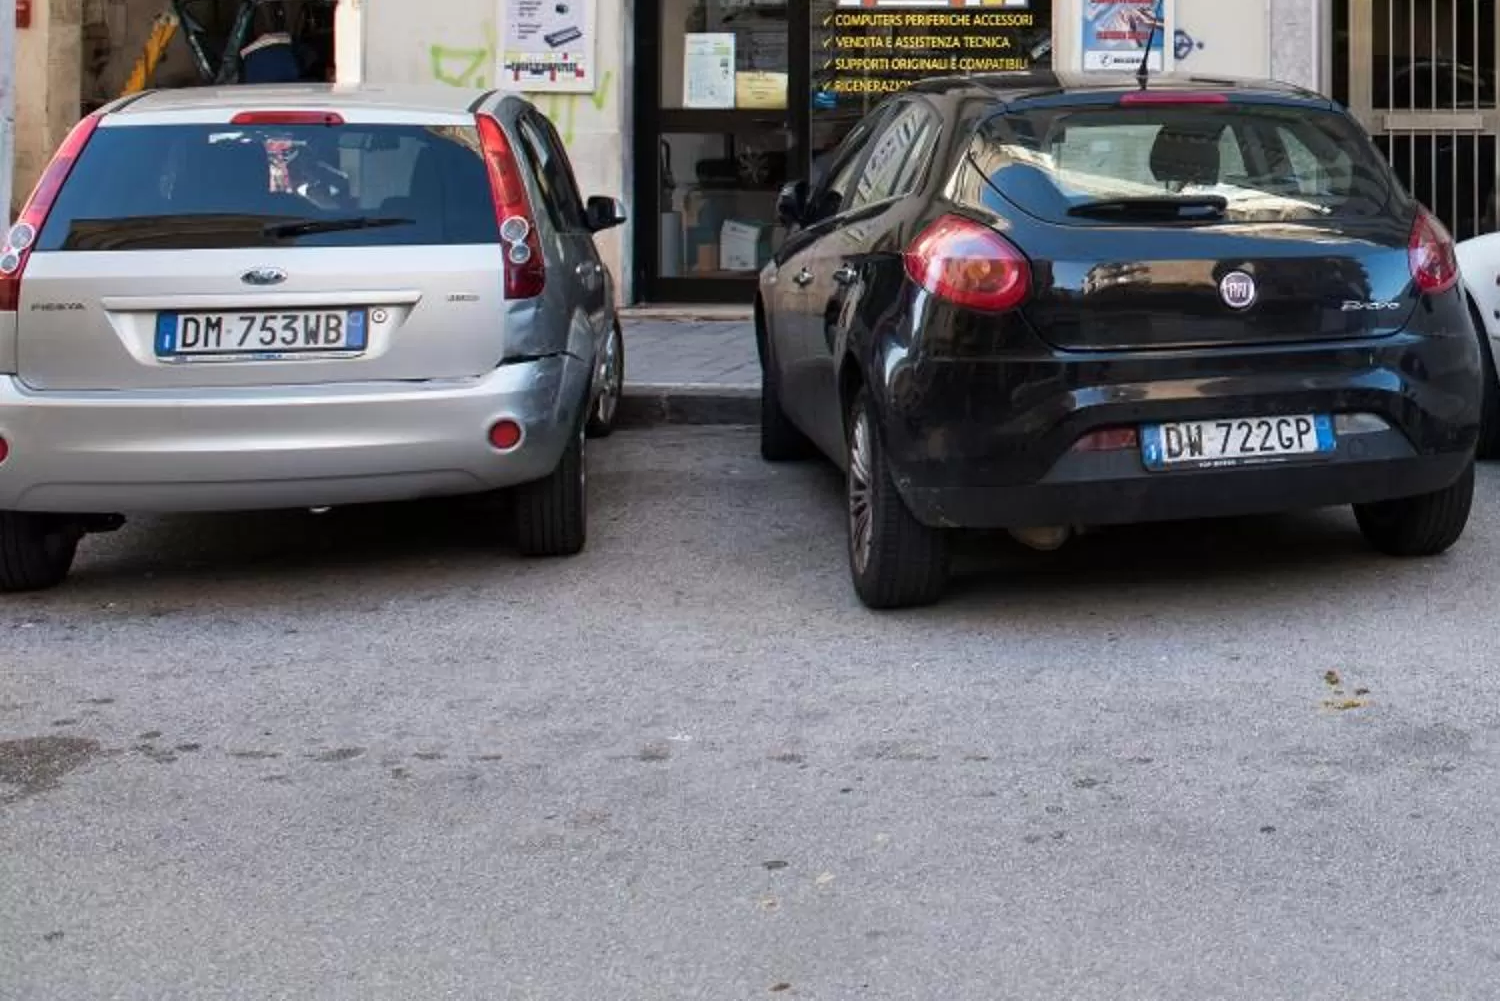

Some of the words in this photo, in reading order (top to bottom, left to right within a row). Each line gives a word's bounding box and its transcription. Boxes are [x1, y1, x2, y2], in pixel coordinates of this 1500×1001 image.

[835, 14, 902, 26] COMPUTERS
[905, 14, 971, 26] PERIFERICHE
[973, 14, 1033, 26] ACCESSORI
[836, 36, 887, 48] VENDITA
[887, 36, 893, 48] E
[895, 36, 960, 48] ASSISTENZA
[963, 36, 1010, 48] TECNICA
[835, 58, 889, 70] SUPPORTI
[892, 58, 949, 70] ORIGINALI
[959, 58, 1028, 70] COMPATIBILI
[181, 314, 223, 348] DM
[237, 312, 342, 347] 753WB
[1164, 424, 1202, 460] DW
[1215, 417, 1312, 456] 722GP
